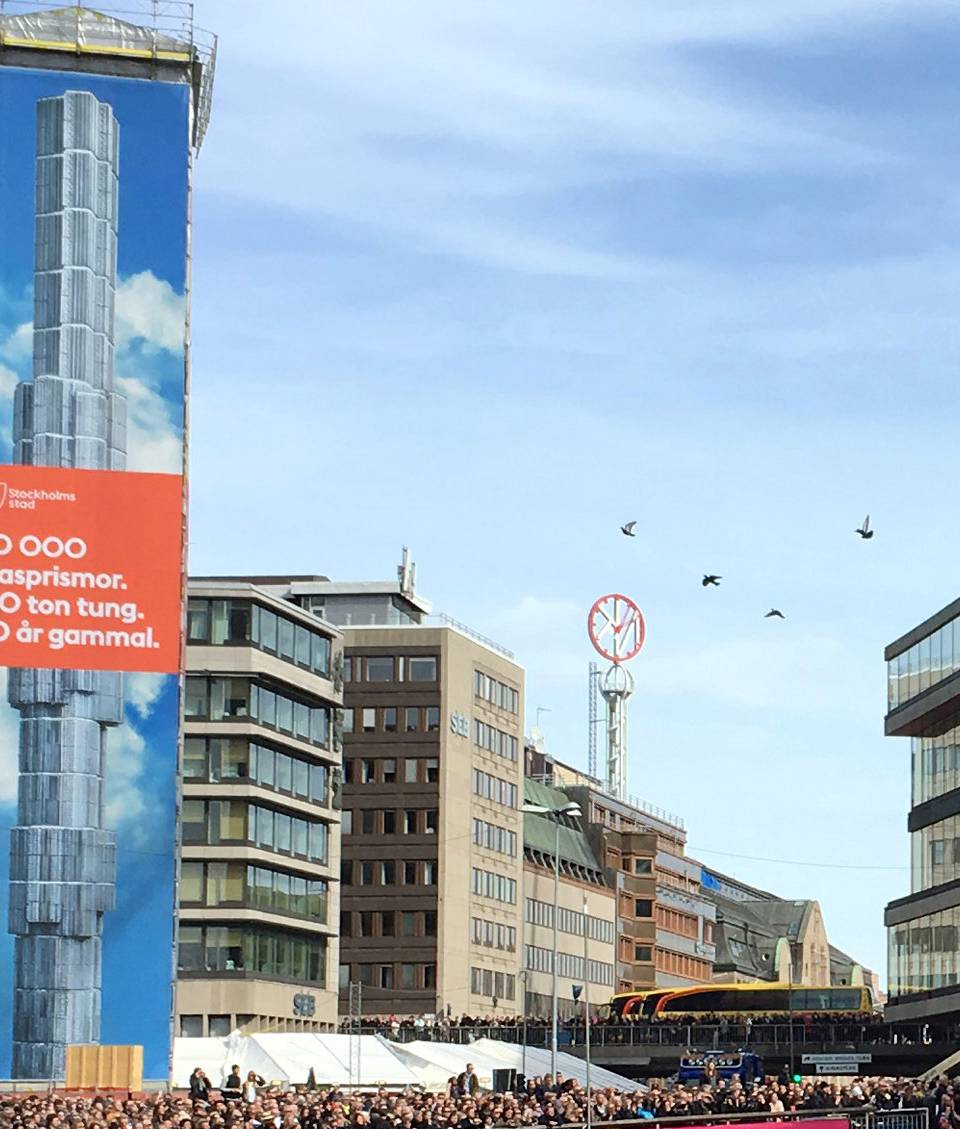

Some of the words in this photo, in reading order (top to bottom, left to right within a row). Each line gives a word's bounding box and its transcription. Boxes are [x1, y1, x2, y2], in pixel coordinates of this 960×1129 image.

[9, 488, 76, 502] Stockholms
[9, 500, 35, 509] stad
[19, 535, 87, 559] 000
[0, 565, 128, 590] asprismor.
[26, 596, 70, 617] ton
[77, 598, 144, 624] tung.
[16, 620, 43, 644] år
[49, 627, 160, 650] gammal.
[293, 993, 316, 1017] SEB
